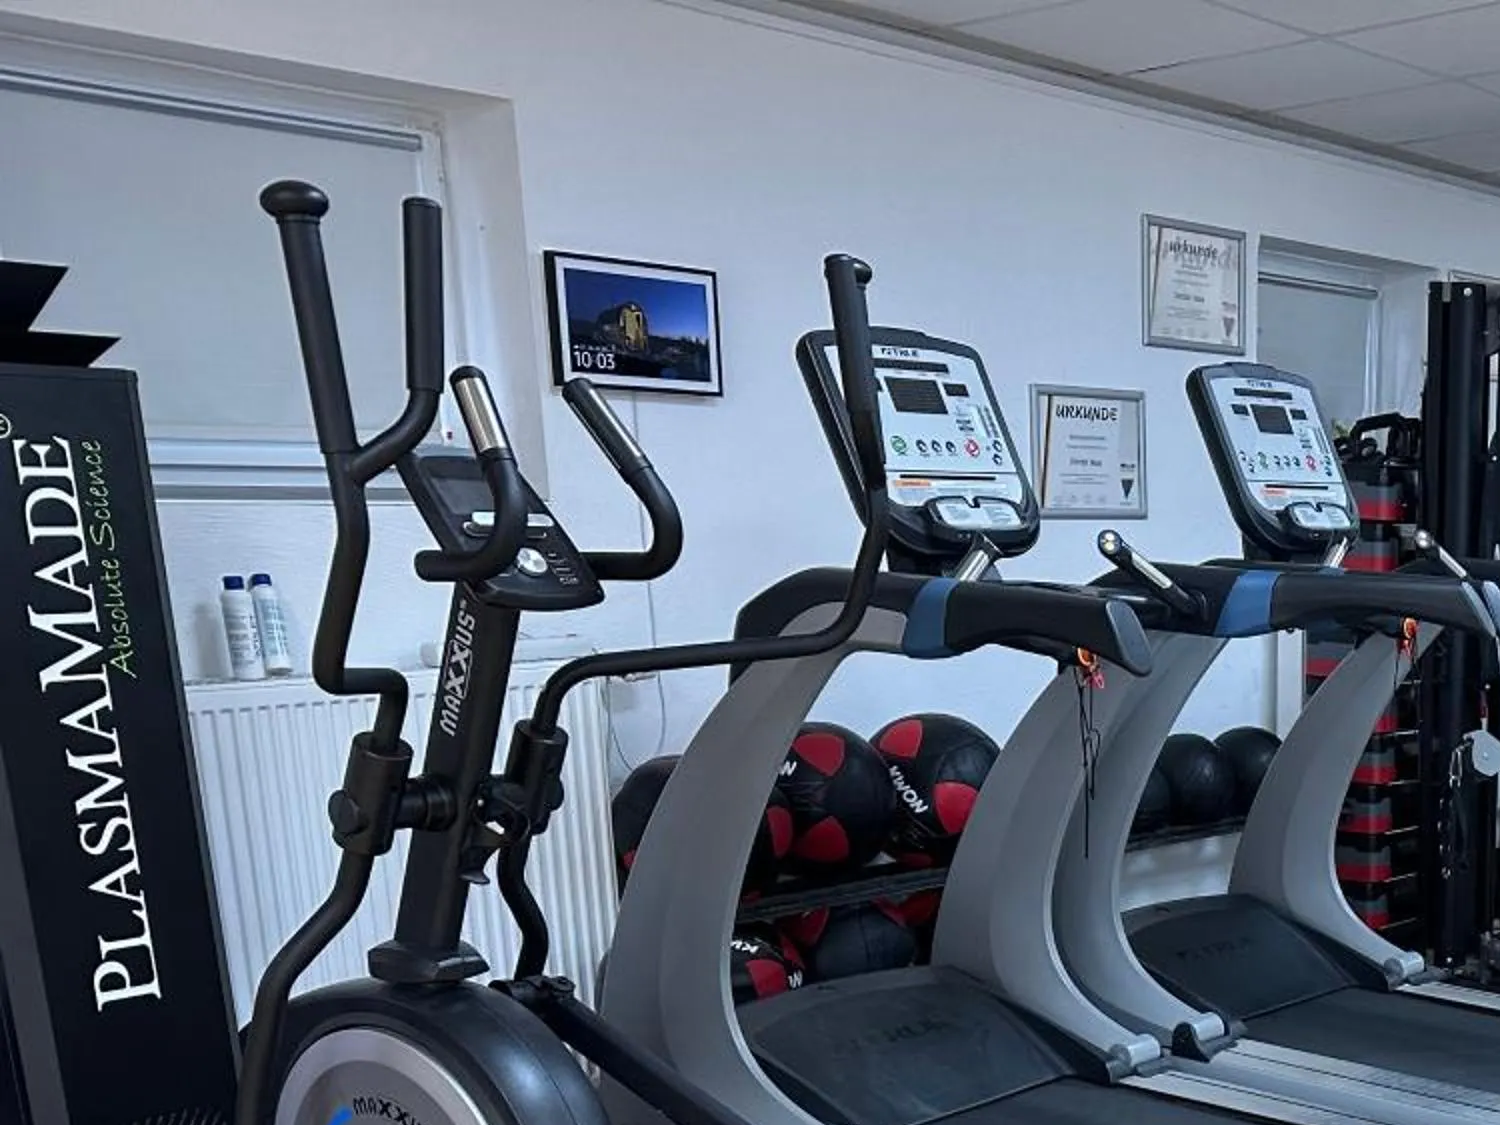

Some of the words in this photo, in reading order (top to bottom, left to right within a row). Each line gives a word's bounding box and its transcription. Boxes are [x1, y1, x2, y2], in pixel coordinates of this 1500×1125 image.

[82, 440, 116, 551] Science
[102, 559, 138, 679] Absolute
[13, 435, 162, 1011] PLASMAMADE
